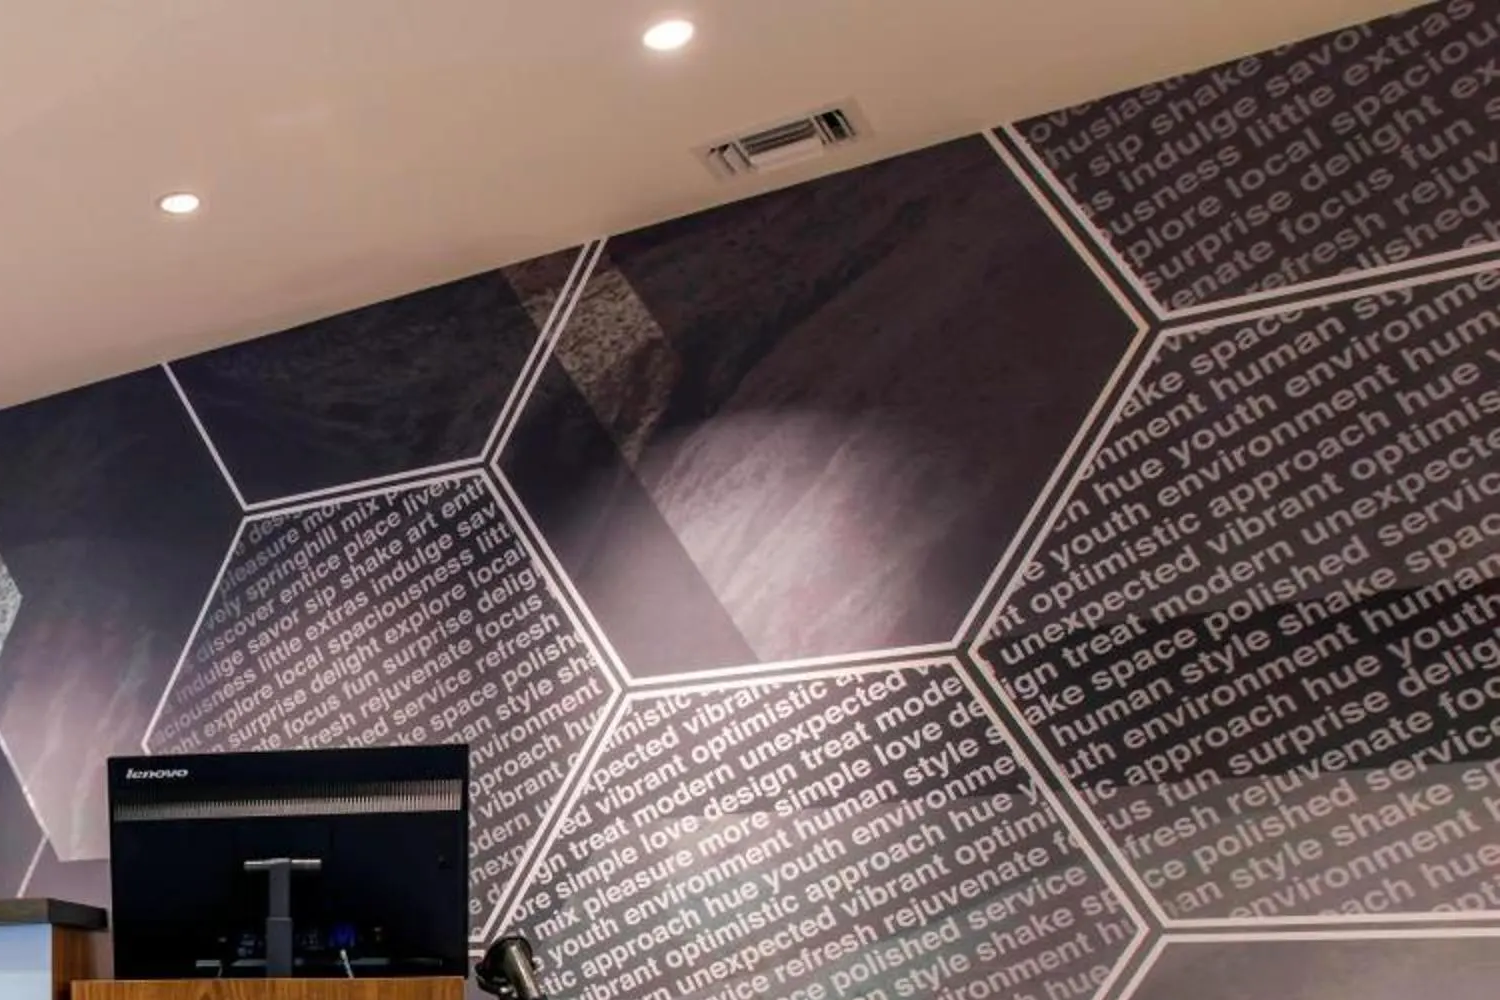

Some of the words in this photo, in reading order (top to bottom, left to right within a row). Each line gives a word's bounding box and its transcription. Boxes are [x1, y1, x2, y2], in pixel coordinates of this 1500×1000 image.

[1090, 131, 1142, 176] sip
[1152, 54, 1262, 135] shake
[1247, 85, 1335, 149] little
[1343, 0, 1474, 89] extras
[1118, 96, 1257, 194] indulge
[1140, 189, 1293, 292] surprise
[1300, 91, 1442, 195] delight
[1226, 124, 1321, 201] local
[1277, 166, 1394, 246] focus
[1398, 117, 1474, 174] fun
[1210, 315, 1345, 403] human
[1029, 512, 1200, 613] optimistic
[1210, 409, 1391, 517] approach
[1396, 362, 1480, 418] hue
[1049, 499, 1150, 572] youth
[1157, 358, 1400, 507] environment
[1093, 456, 1163, 505] hue
[1169, 392, 1276, 470] youth
[218, 528, 299, 599] pleasure
[244, 522, 337, 600] springhill
[341, 497, 379, 533] mix
[247, 609, 301, 654] savor
[305, 584, 336, 614] sip
[340, 539, 403, 590] shake
[407, 510, 439, 544] art
[257, 637, 302, 674] little
[306, 592, 368, 642] extras
[370, 535, 453, 597] indulge
[280, 555, 340, 604] entice
[344, 513, 401, 565] place
[1002, 543, 1199, 665] unexpected
[1206, 469, 1342, 559] vibrant
[1061, 609, 1145, 670] treat
[1150, 539, 1293, 625] modern
[1091, 627, 1196, 691] space
[1205, 534, 1367, 643] polished
[203, 683, 273, 737] explore
[274, 644, 324, 690] local
[326, 550, 473, 655] spaciousness
[227, 687, 306, 747] surprise
[309, 634, 381, 693] delight
[384, 583, 465, 644] explore
[468, 538, 526, 589] local
[282, 694, 341, 740] focus
[342, 669, 379, 701] fun
[383, 610, 472, 675] surprise
[359, 638, 472, 718] rejuvenate
[474, 594, 542, 644] focus
[393, 668, 471, 725] service
[476, 612, 560, 674] refresh
[431, 682, 497, 731] space
[497, 678, 553, 720] style
[1050, 676, 1173, 748] human
[1182, 629, 1270, 684] style
[1279, 568, 1396, 636] shake
[1123, 620, 1356, 749] environment
[126, 768, 189, 779] lenovo
[569, 815, 629, 861] treat
[632, 763, 734, 828] modern
[739, 665, 907, 771] unexpected
[596, 752, 687, 816] vibrant
[691, 681, 827, 764] optimistic
[1124, 692, 1297, 785] approach
[1303, 655, 1381, 703] hue
[1157, 766, 1220, 807] fun
[1229, 690, 1388, 775] surprise
[1226, 711, 1433, 816] rejuvenate
[481, 758, 564, 820] vibrant
[534, 906, 580, 940] mix
[583, 849, 693, 922] pleasure
[698, 807, 775, 857] more
[776, 758, 871, 817] simple
[874, 722, 943, 767] love
[548, 918, 618, 969] youth
[625, 826, 792, 925] environment
[793, 778, 898, 841] human
[904, 739, 978, 786] style
[556, 846, 637, 898] simple
[640, 814, 700, 855] love
[704, 763, 797, 822] design
[799, 719, 872, 772] treat
[1194, 776, 1356, 875] polished
[1233, 839, 1322, 888] style
[1332, 783, 1453, 847] shake
[581, 908, 700, 977] approach
[704, 881, 757, 917] hue
[762, 837, 846, 895] youth
[664, 893, 798, 967] optimistic
[805, 822, 944, 901] approach
[948, 791, 1012, 832] hue
[676, 902, 837, 995] unexpected
[840, 851, 950, 919] vibrant
[775, 924, 878, 983] refresh
[883, 848, 1048, 935] rejuvenate
[1421, 844, 1500, 890] hue
[831, 915, 961, 999] polished
[968, 867, 1086, 931] service
[895, 954, 969, 997] style
[977, 909, 1073, 962] shake
